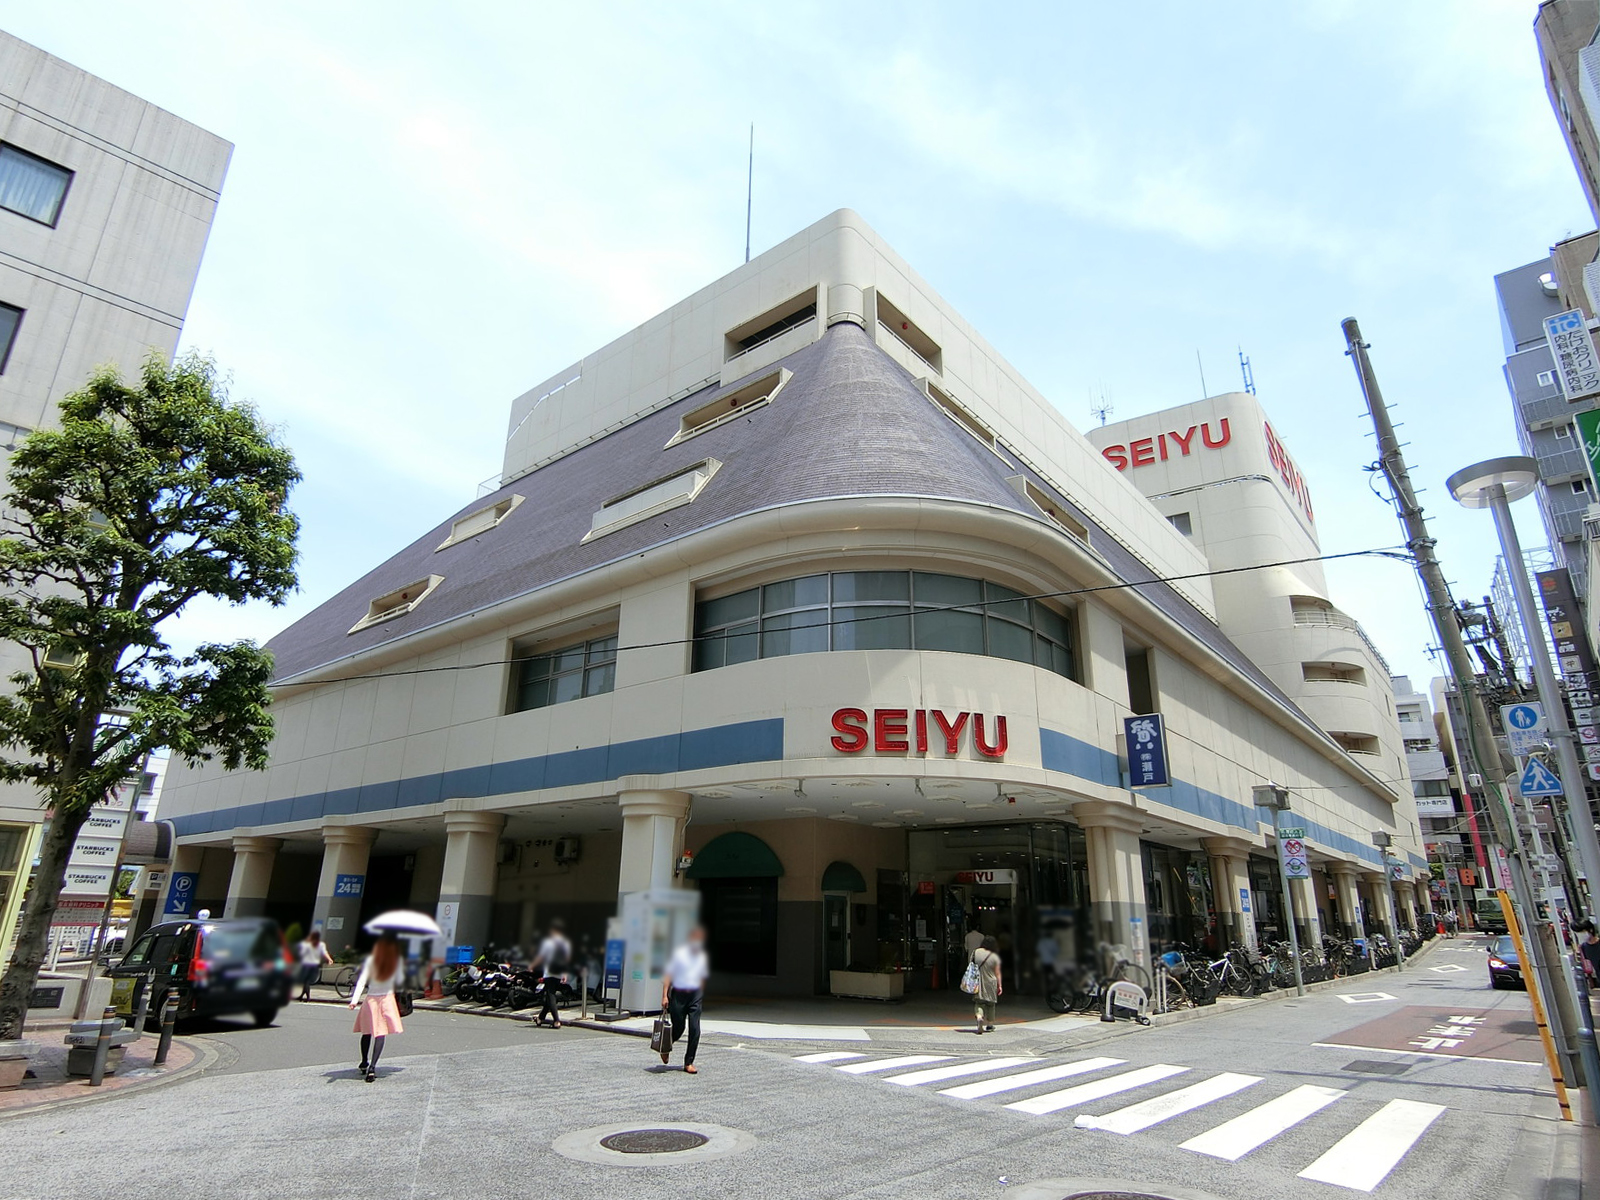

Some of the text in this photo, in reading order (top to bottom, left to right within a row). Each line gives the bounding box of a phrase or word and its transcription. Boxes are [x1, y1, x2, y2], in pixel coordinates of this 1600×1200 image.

[1102, 417, 1232, 471] SEIYU
[1264, 420, 1314, 526] SEIYU
[831, 708, 1009, 758] SEIYU
[337, 883, 351, 893] 24
